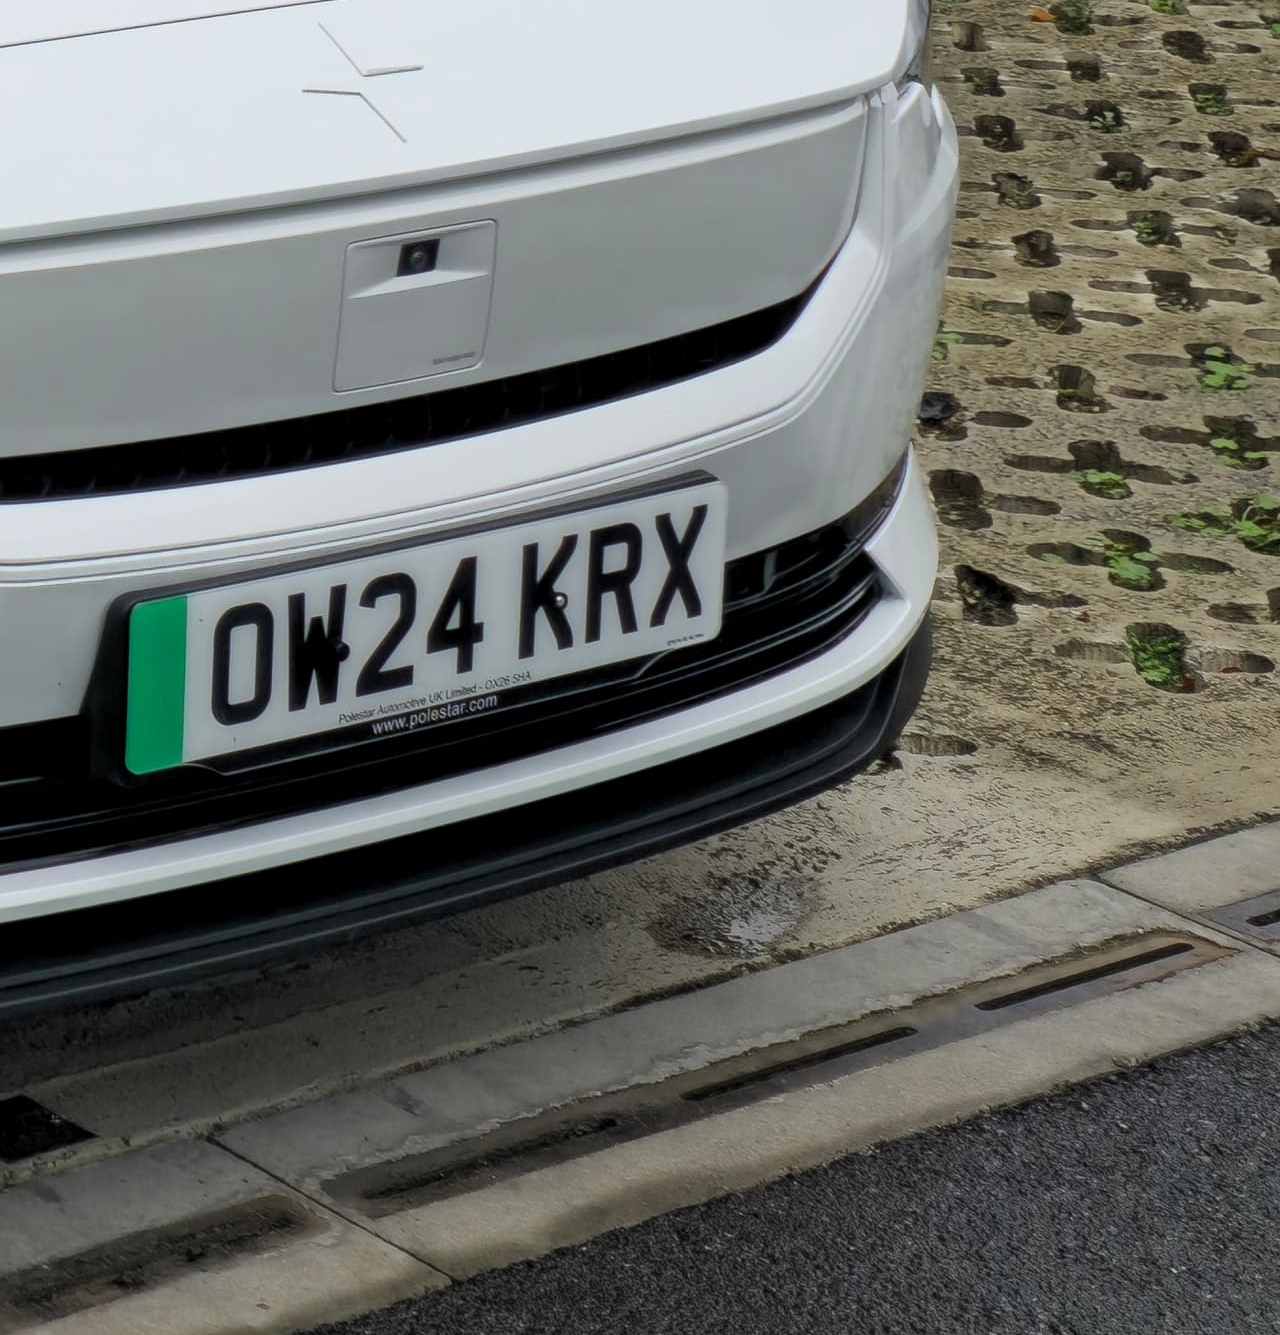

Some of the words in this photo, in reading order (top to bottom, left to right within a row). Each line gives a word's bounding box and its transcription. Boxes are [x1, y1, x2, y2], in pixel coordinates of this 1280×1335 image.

[211, 555, 484, 726] OW24
[517, 504, 708, 659] KRX
[338, 708, 377, 724] Polestar
[377, 697, 428, 717] Automotive
[428, 690, 444, 704] UK
[444, 683, 477, 700] Limited
[371, 694, 498, 736] www.polestar.com
